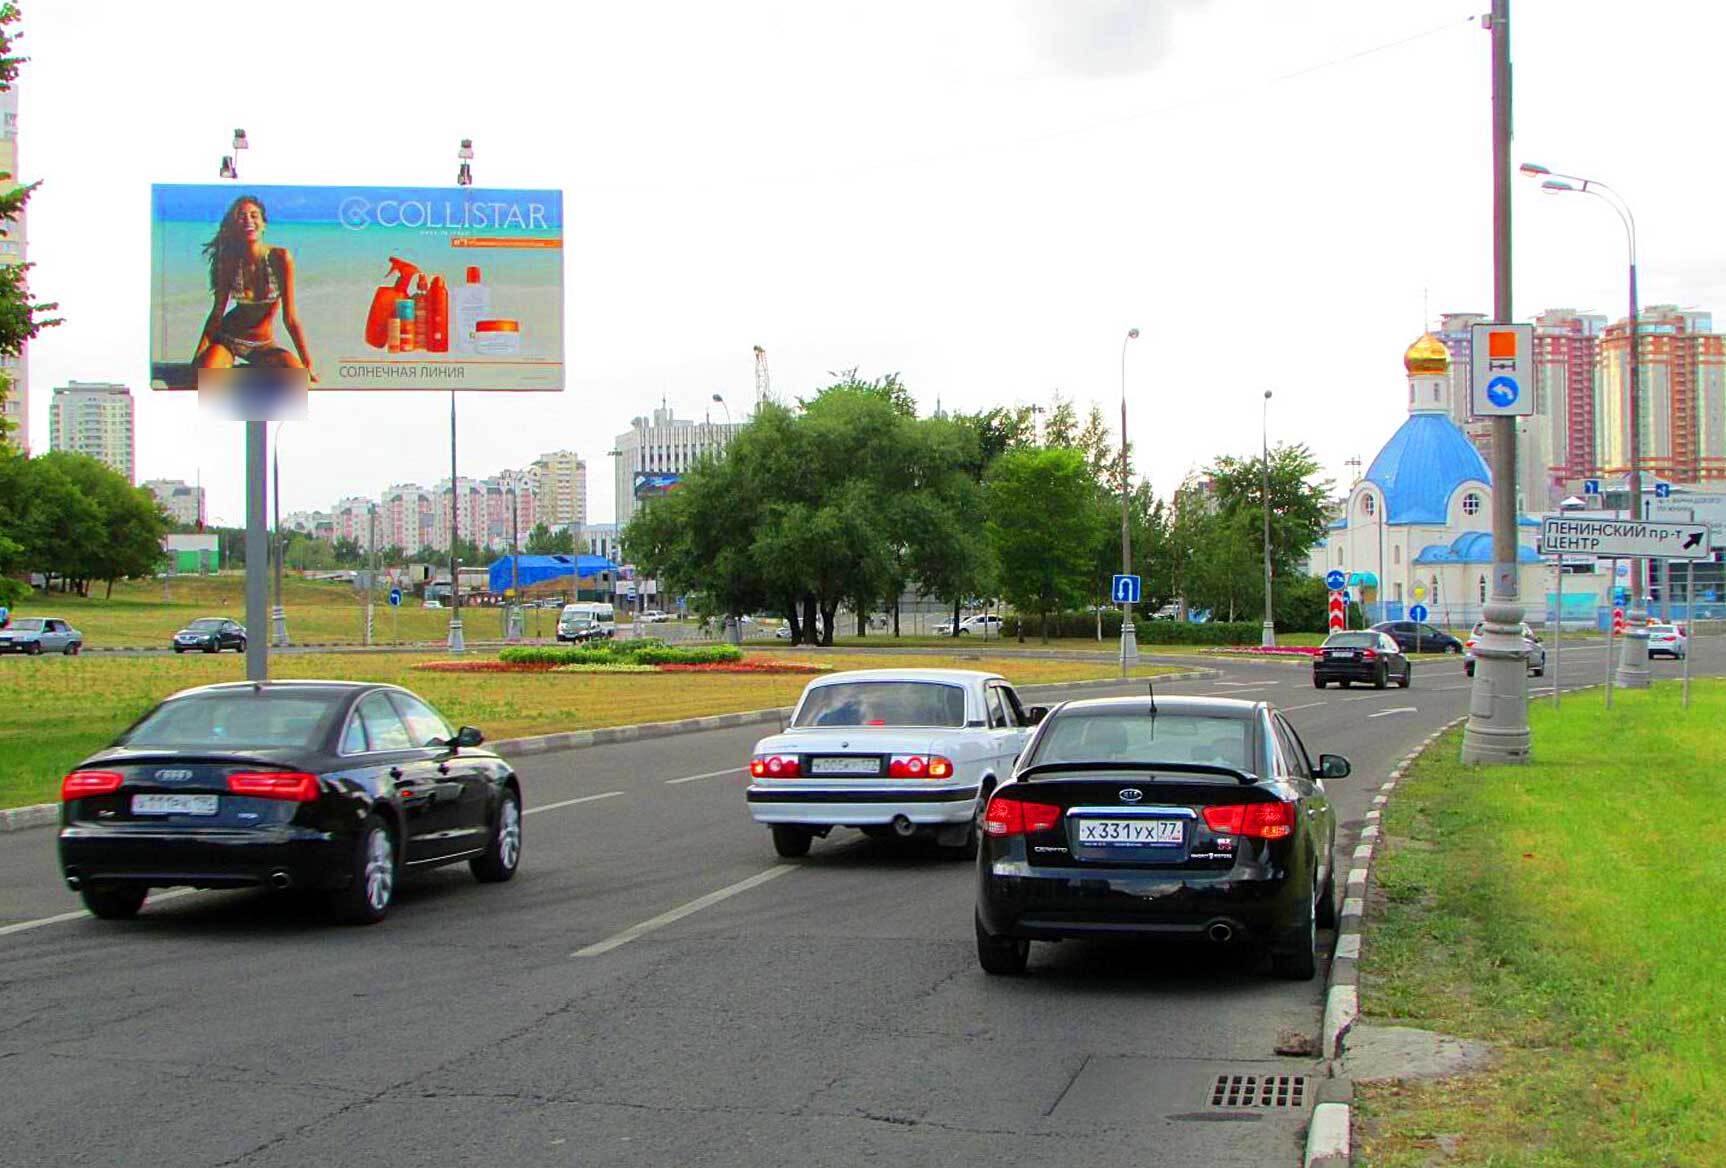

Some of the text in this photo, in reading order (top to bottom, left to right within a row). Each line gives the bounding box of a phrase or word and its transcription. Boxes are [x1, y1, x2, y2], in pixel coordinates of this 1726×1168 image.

[376, 200, 548, 229] COLLISTAR
[339, 366, 465, 379] СОЛНЕЧНАЯ ЛИНИЯ
[1547, 521, 1646, 539] ЛЕНИНСКИЙ
[1546, 537, 1600, 550] ЦЕНТР
